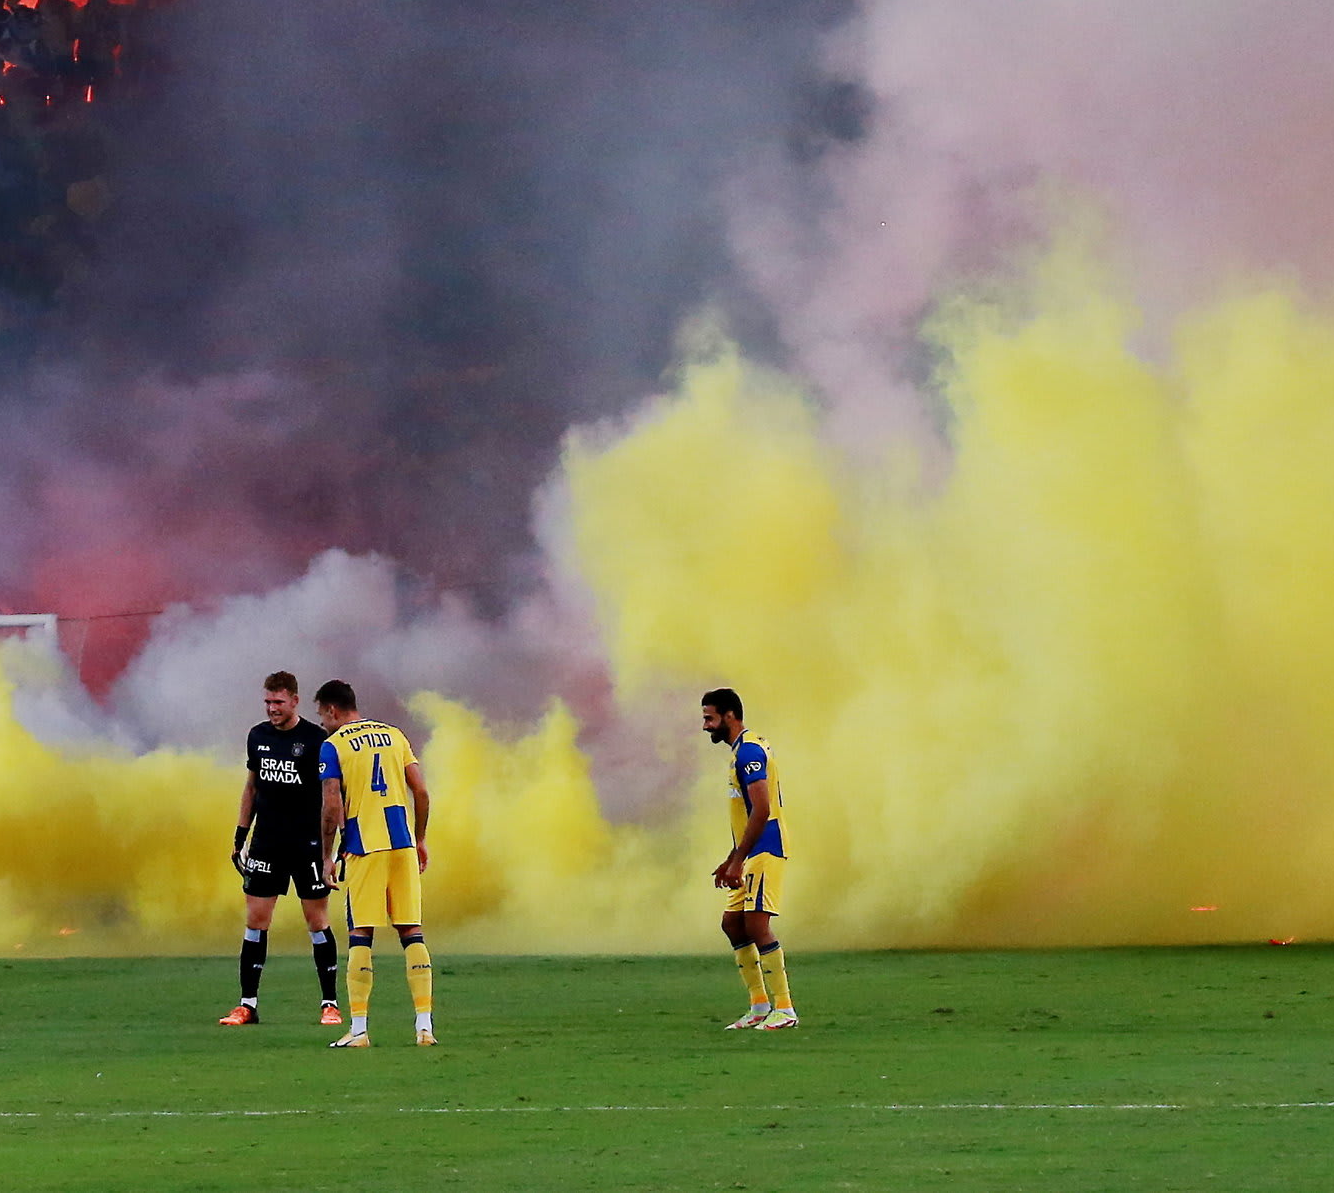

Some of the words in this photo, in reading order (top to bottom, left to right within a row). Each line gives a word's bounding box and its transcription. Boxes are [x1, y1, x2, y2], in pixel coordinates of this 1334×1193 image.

[261, 757, 298, 773] ISRAEL
[259, 769, 303, 785] CANADA
[371, 753, 388, 797] 4
[310, 861, 319, 882] 1
